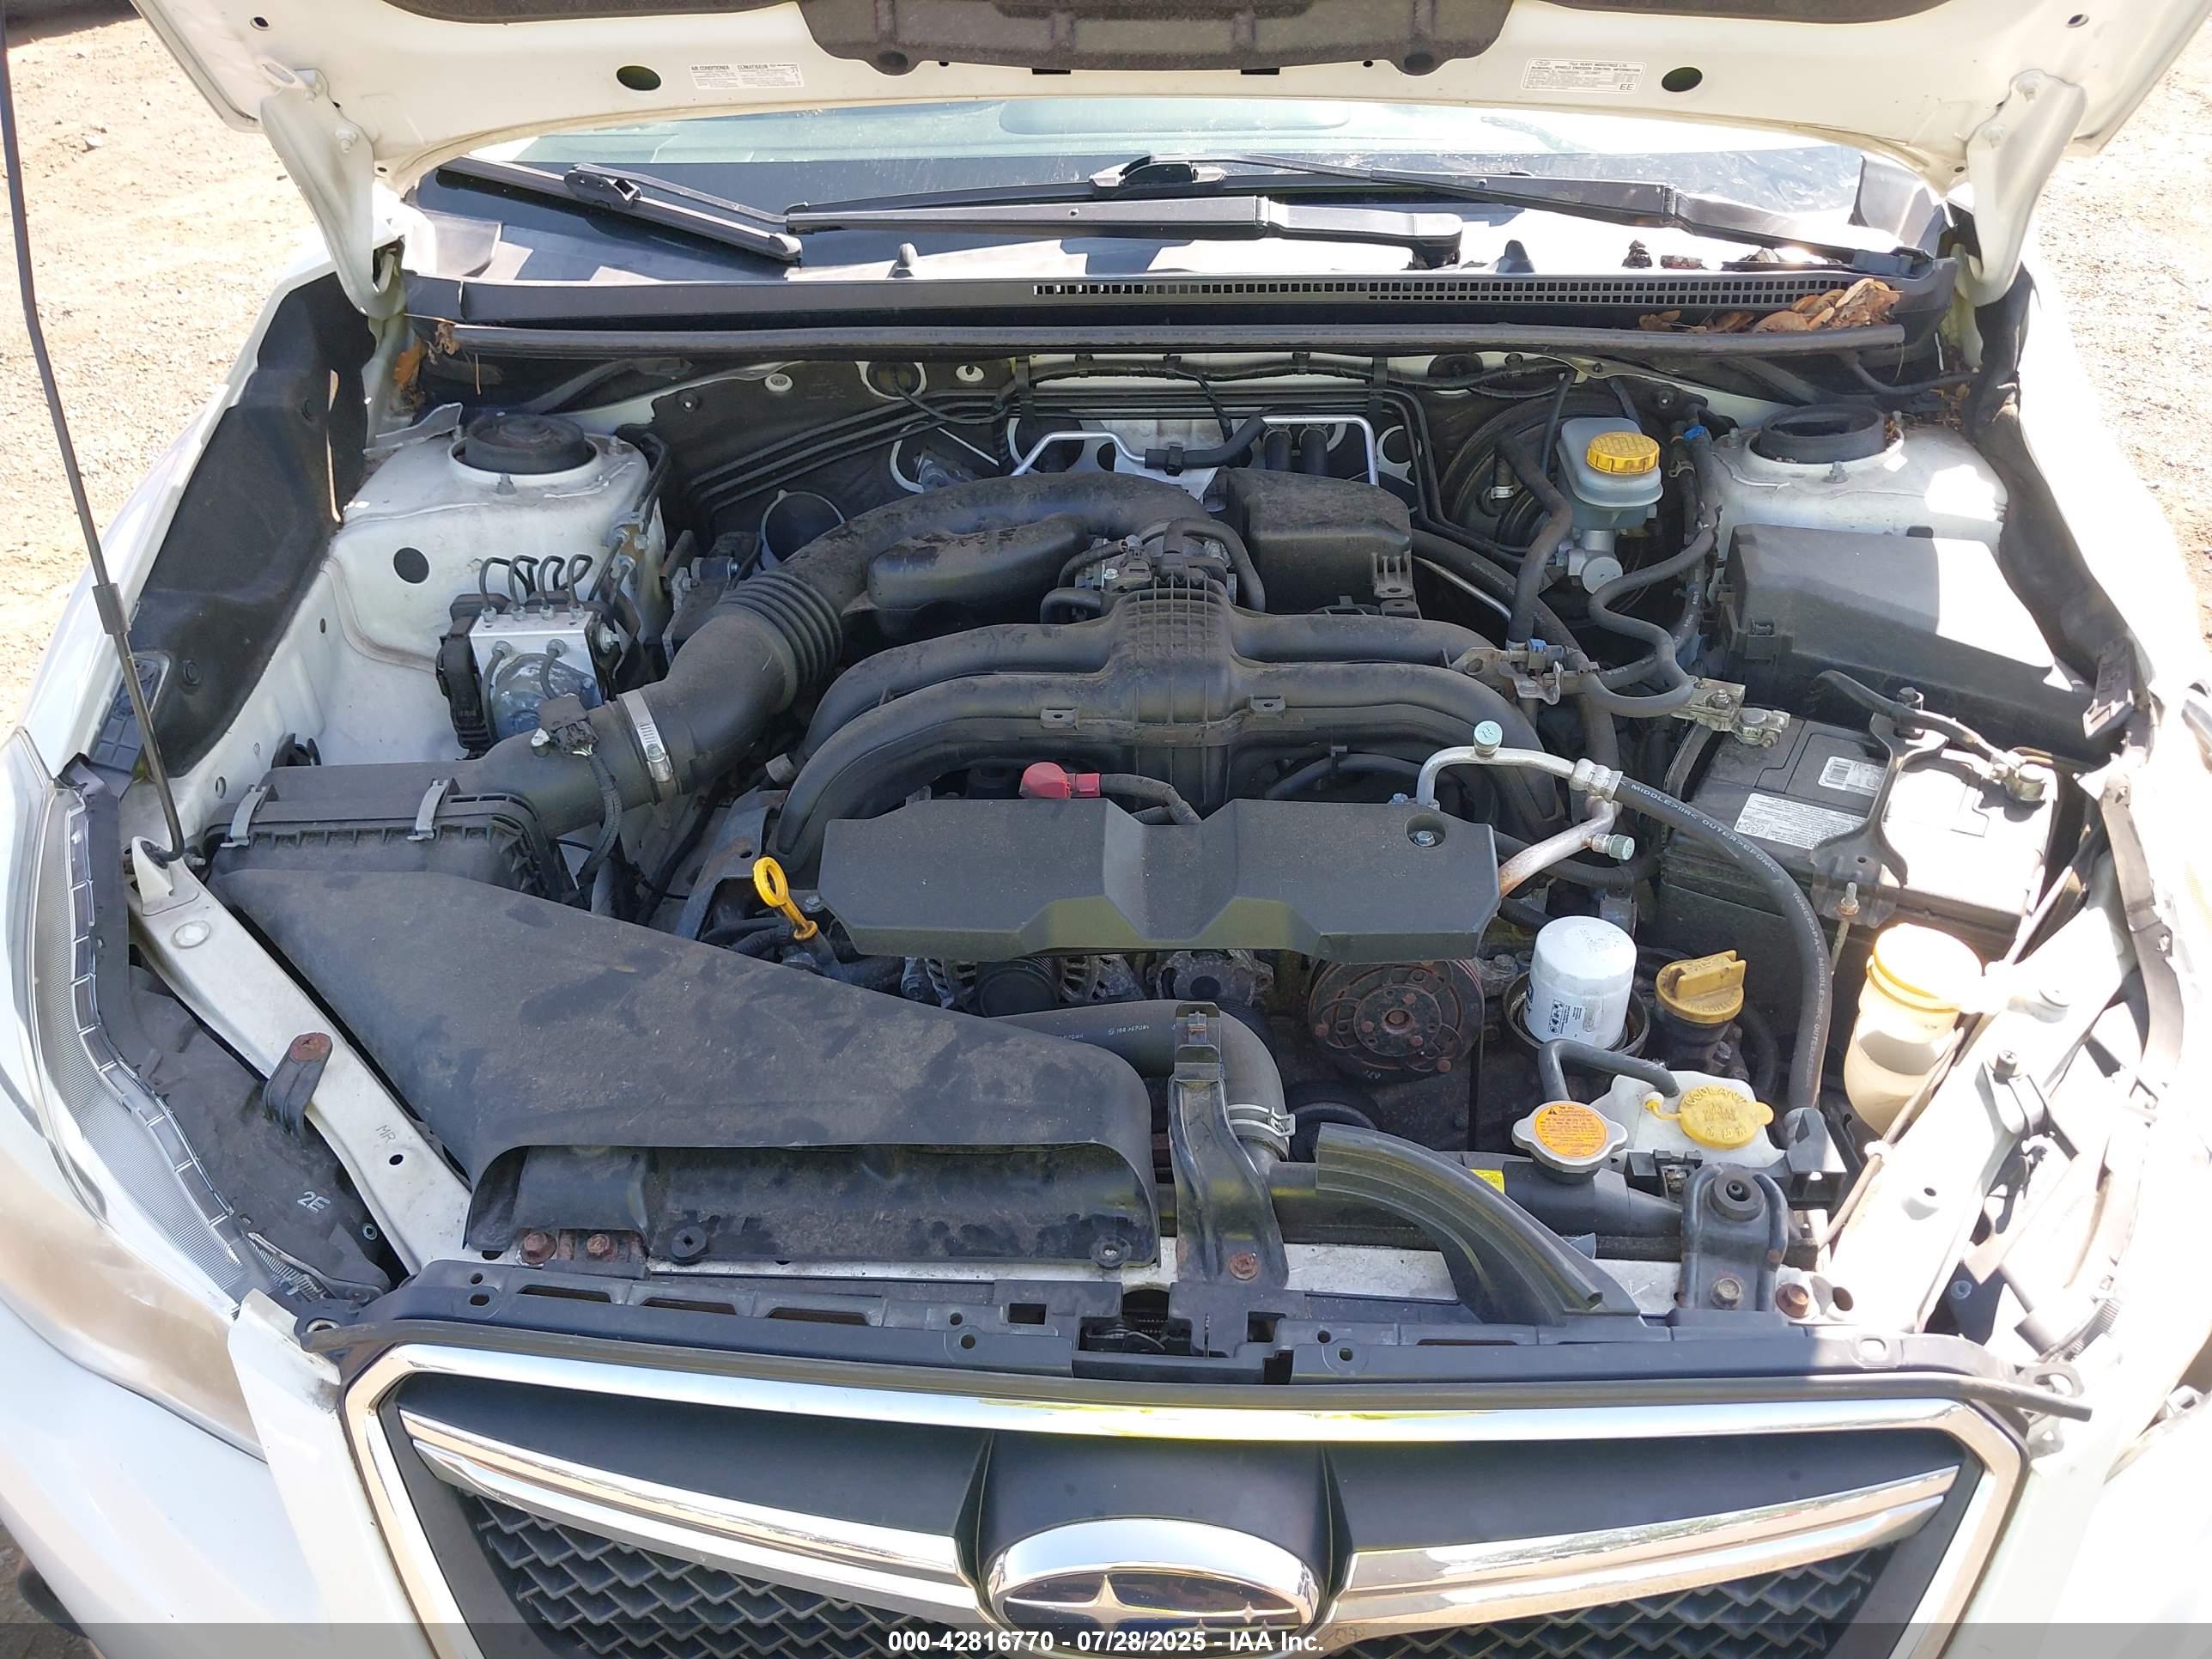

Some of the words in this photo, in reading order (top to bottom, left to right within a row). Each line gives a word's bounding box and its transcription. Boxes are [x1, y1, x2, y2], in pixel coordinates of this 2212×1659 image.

[1684, 1085, 1747, 1106] COOLANT
[375, 1125, 397, 1144] MR
[296, 1190, 331, 1213] 2E
